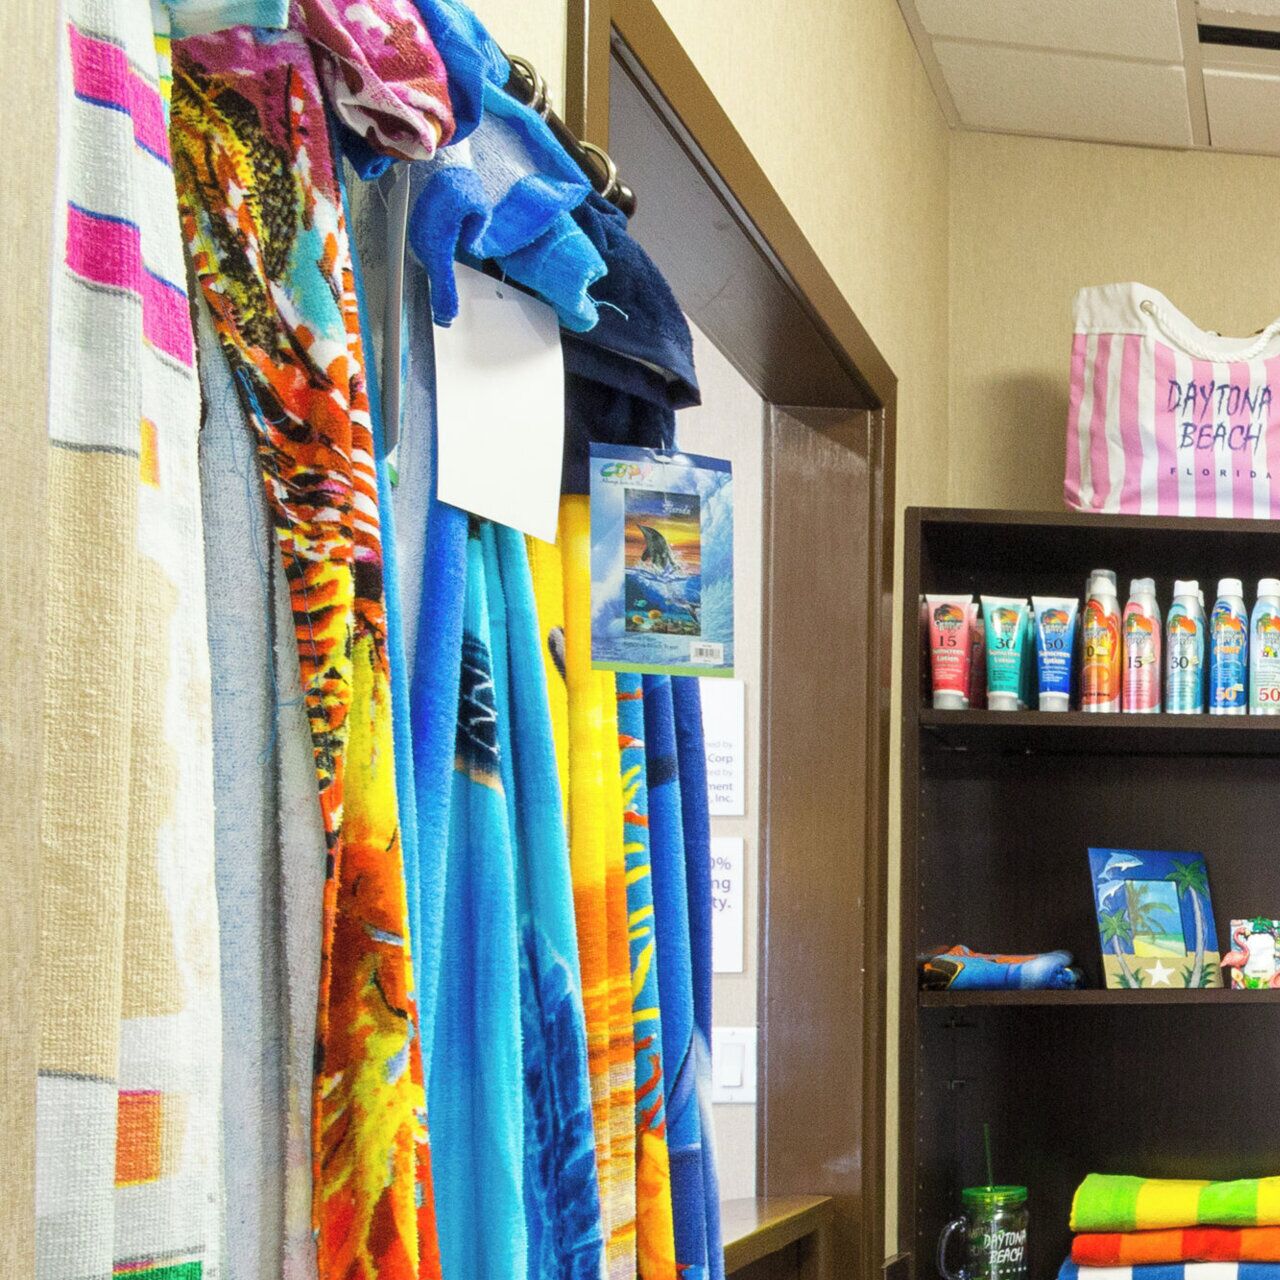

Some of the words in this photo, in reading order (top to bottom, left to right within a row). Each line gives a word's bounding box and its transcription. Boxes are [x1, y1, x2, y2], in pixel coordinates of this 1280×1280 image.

[1168, 380, 1272, 419] DAYTONA
[1181, 422, 1262, 455] BEACH
[1170, 468, 1272, 479] FLORIDA
[939, 636, 957, 647] 15
[1128, 656, 1143, 669] 15
[1170, 656, 1189, 669] 30
[1259, 688, 1280, 701] 50
[984, 1228, 1026, 1249] DAYTONA
[989, 1246, 1024, 1264] BEACH
